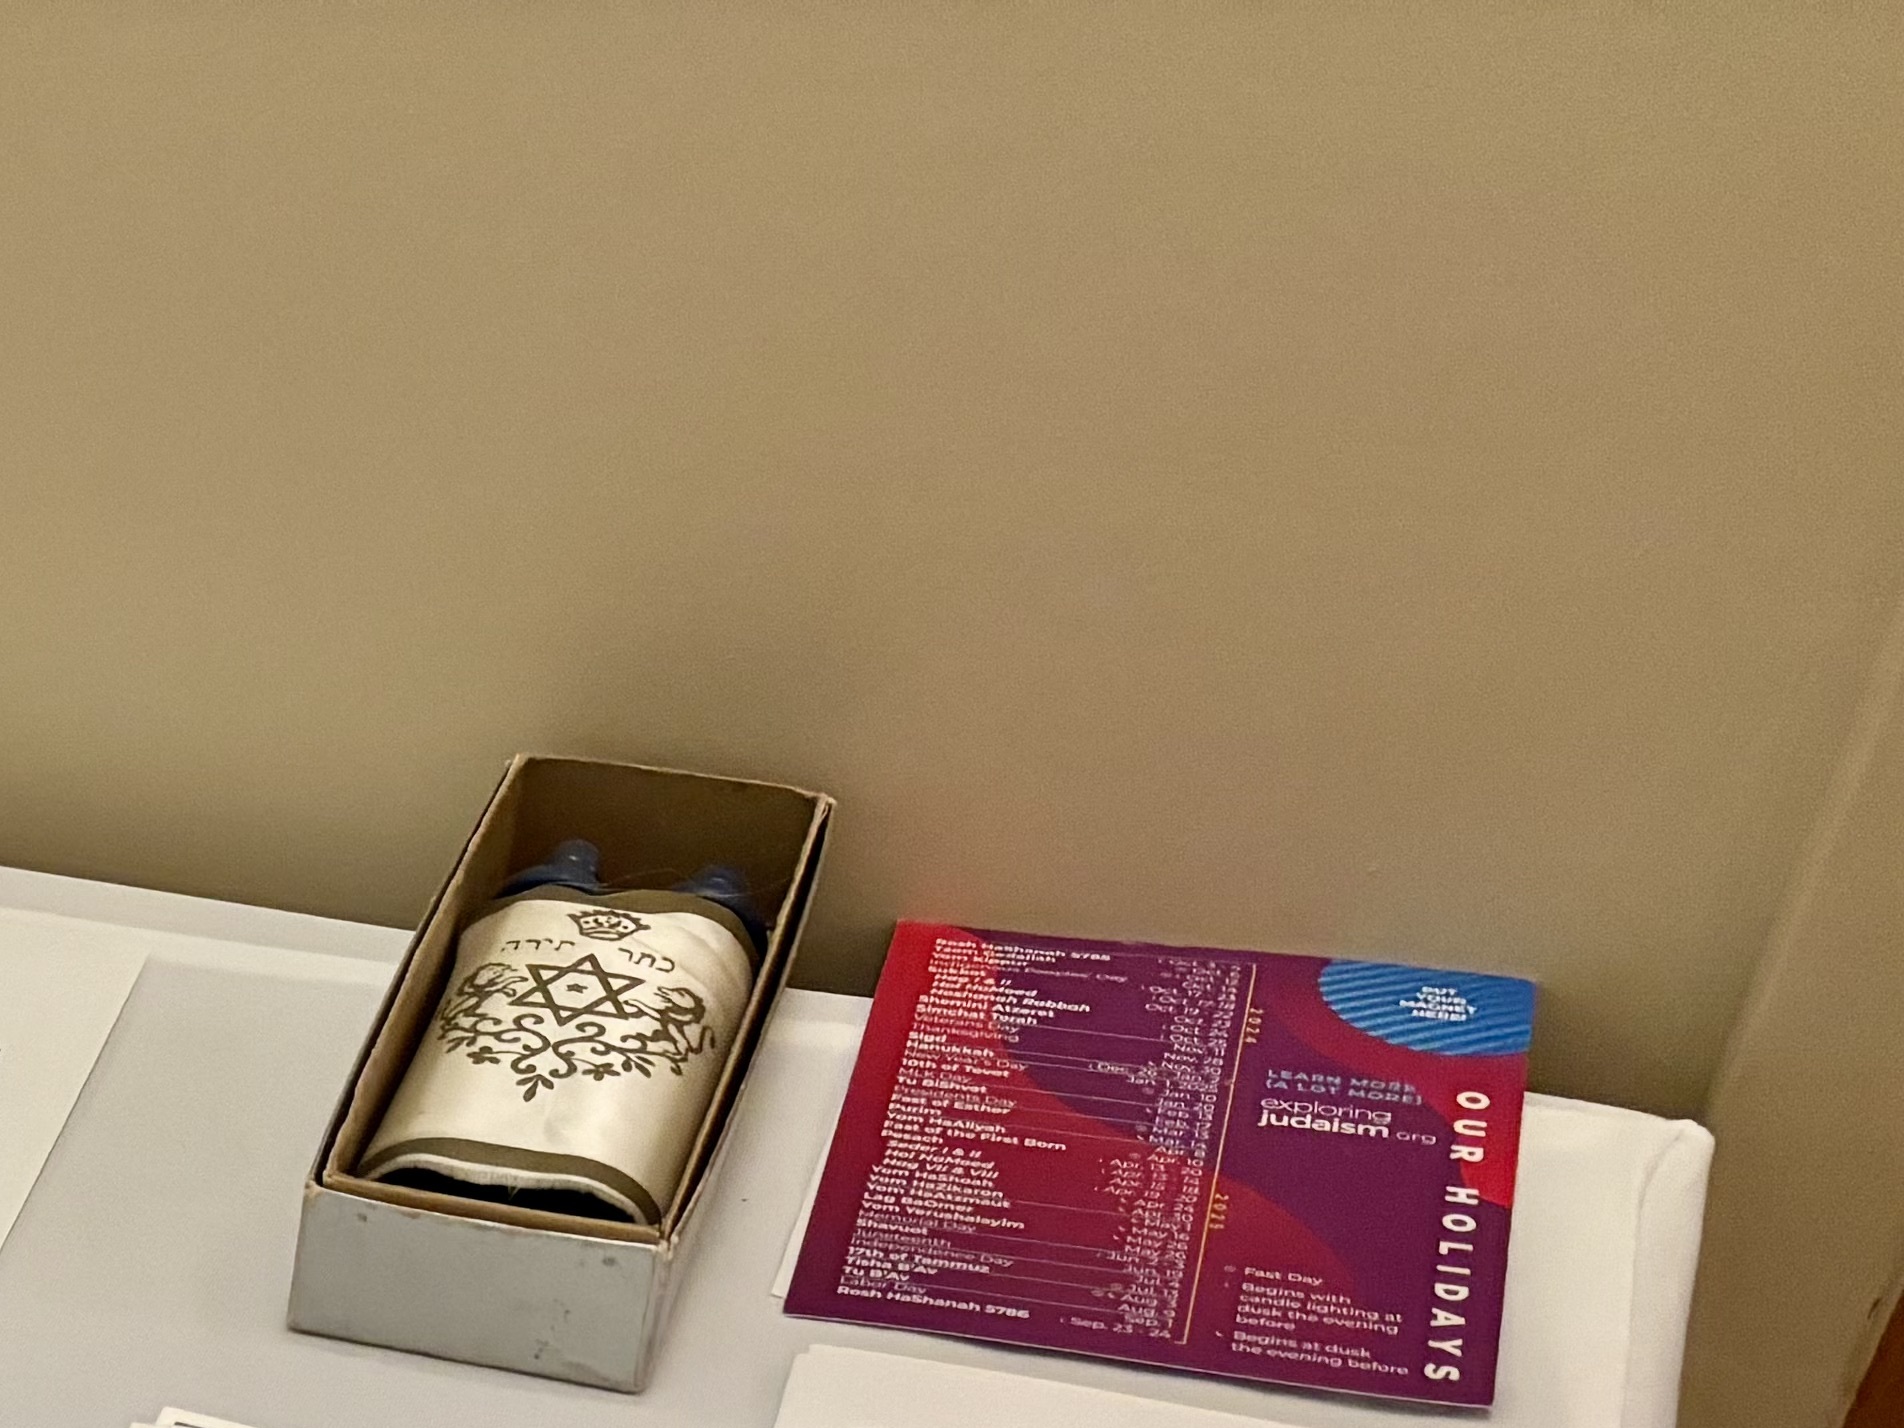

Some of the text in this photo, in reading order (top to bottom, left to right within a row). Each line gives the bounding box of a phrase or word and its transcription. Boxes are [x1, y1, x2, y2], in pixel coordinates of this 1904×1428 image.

[618, 947, 675, 973] כתר
[1415, 992, 1466, 1004] YOUR
[1421, 986, 1456, 995] PUT
[1258, 1109, 1388, 1137] judaism
[1260, 1098, 1391, 1124] exploring
[1425, 1091, 1489, 1379] OUR HOLIDAYS
[1244, 1266, 1322, 1286] Fast Day
[1241, 1282, 1351, 1304] Begins with
[1237, 1304, 1398, 1335] dusk the evening
[1239, 1294, 1402, 1322] candle lighting at
[1235, 1313, 1295, 1330] before
[1233, 1330, 1370, 1358] Begins at dusk
[1231, 1342, 1408, 1374] the evening before
